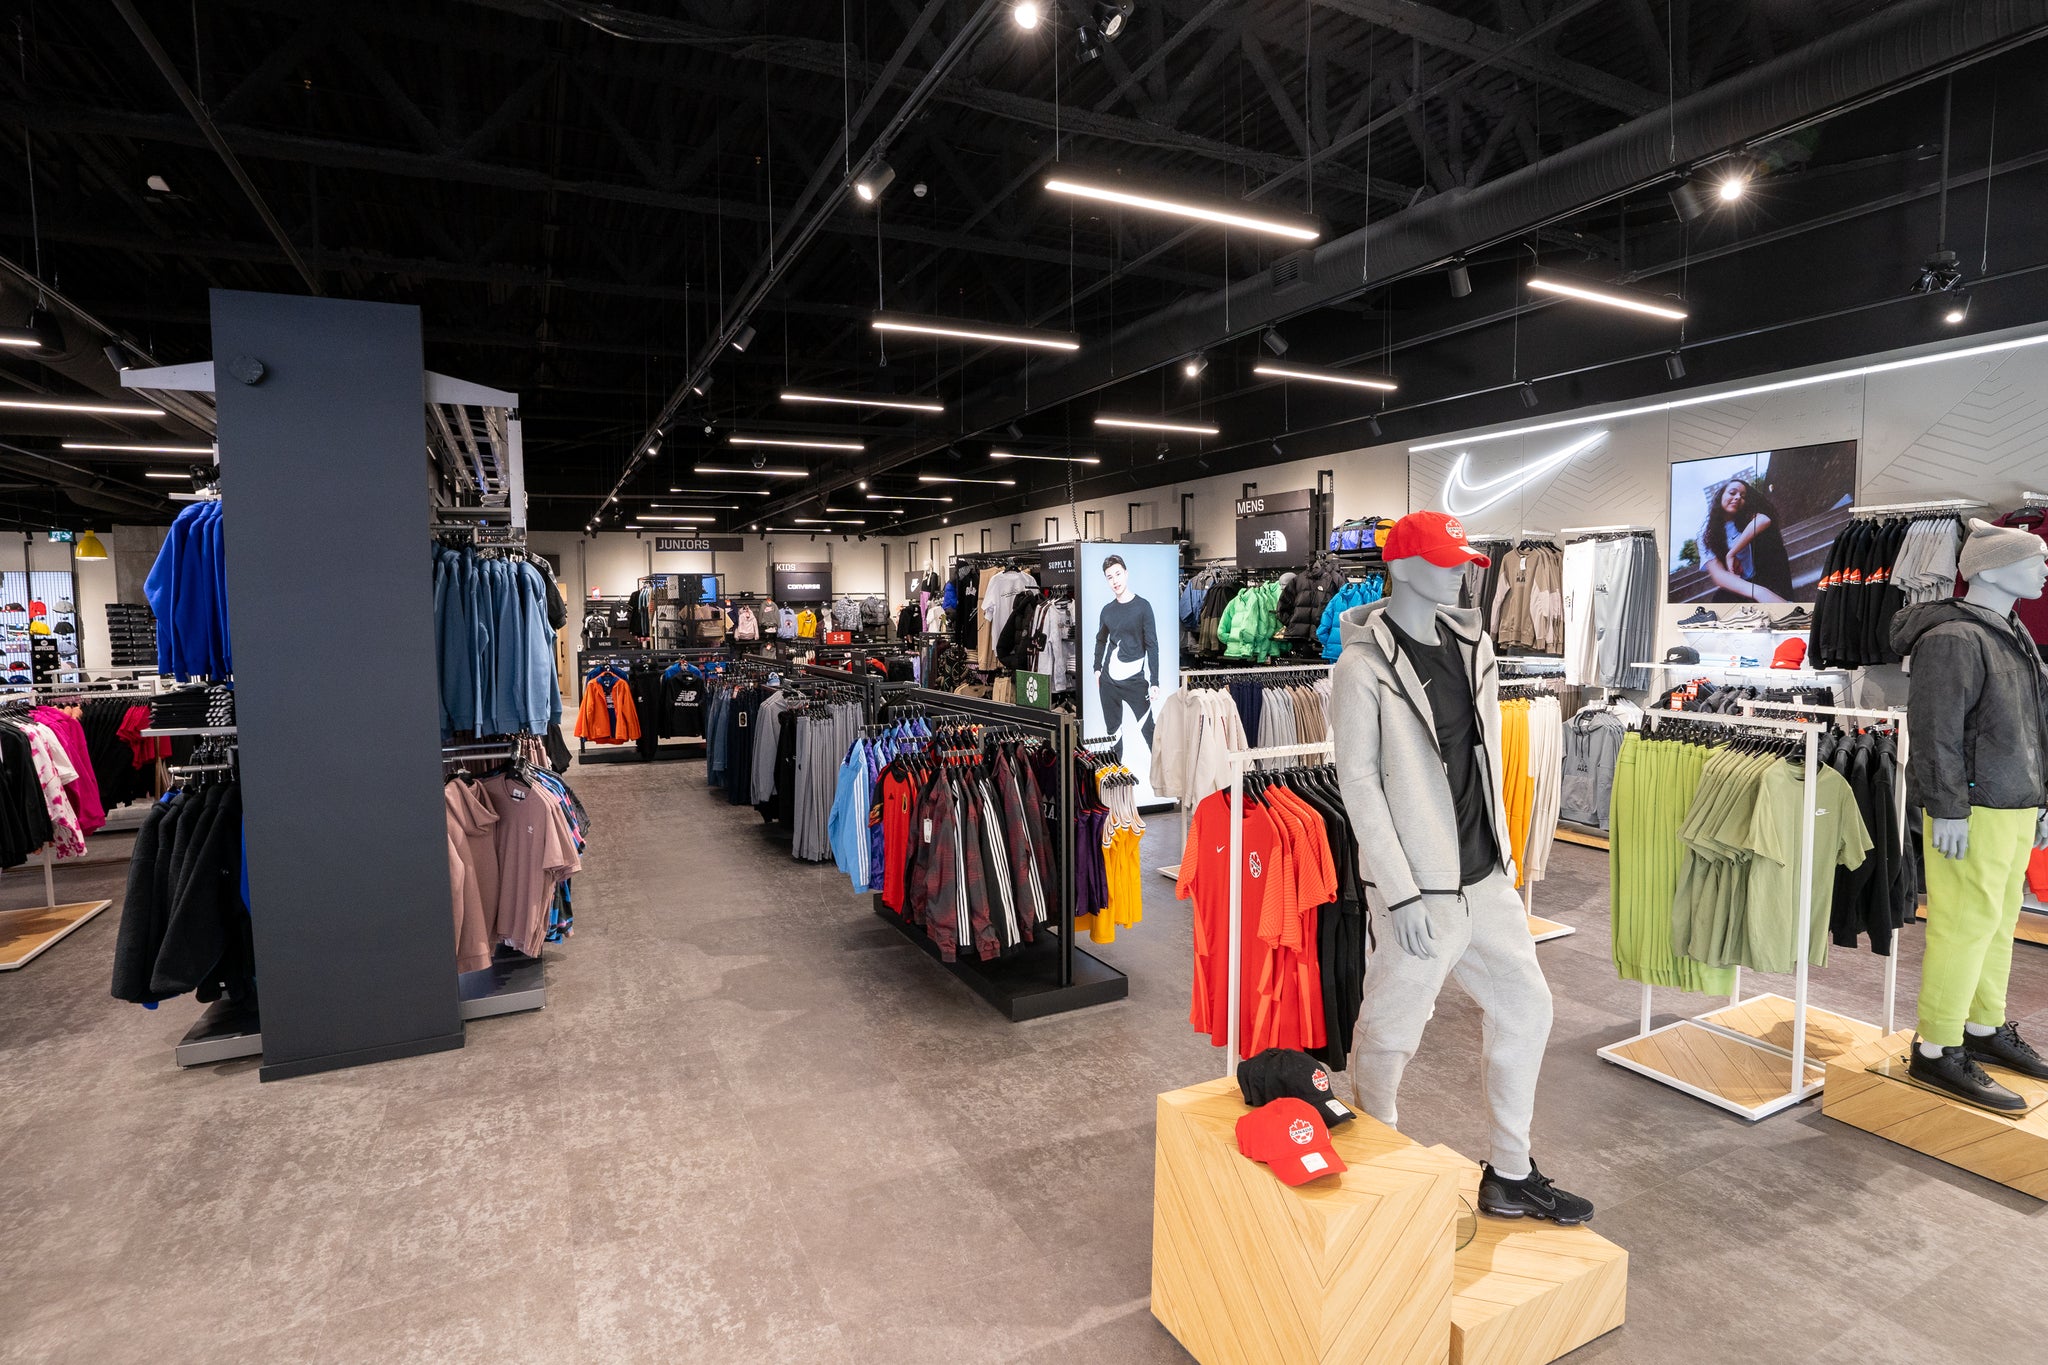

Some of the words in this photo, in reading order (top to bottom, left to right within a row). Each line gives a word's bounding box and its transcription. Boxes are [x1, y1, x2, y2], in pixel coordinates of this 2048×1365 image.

[1237, 499, 1264, 514] MENS
[1264, 531, 1276, 539] THE
[659, 539, 710, 550] JUNIORS
[1255, 538, 1276, 547] NORTH
[1259, 545, 1276, 553] FACE
[776, 563, 796, 571] KIDS
[1048, 560, 1067, 569] SUPPLY
[1067, 560, 1072, 568] &
[1290, 1127, 1312, 1136] CANADA
